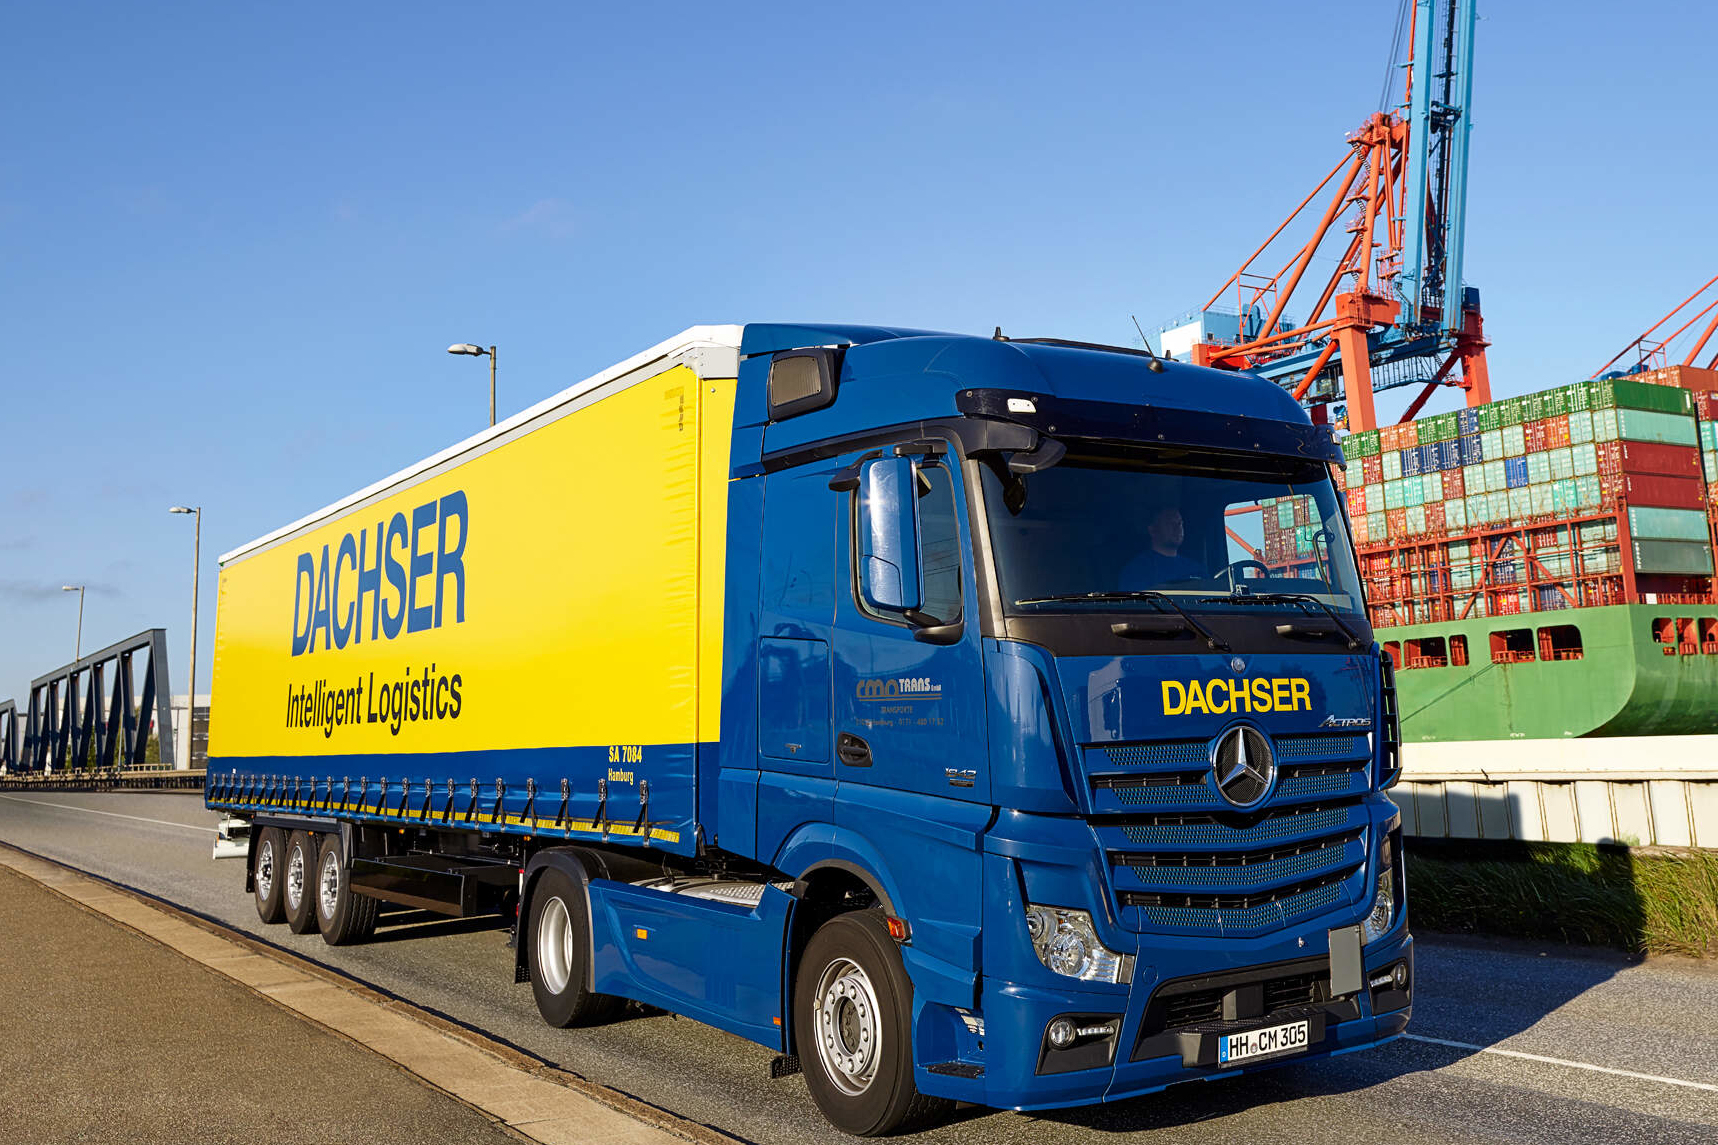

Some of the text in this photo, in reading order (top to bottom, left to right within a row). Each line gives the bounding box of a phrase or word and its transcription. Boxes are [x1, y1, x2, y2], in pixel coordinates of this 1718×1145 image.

[291, 489, 469, 656] DACHSER
[287, 663, 462, 738] Intelligent Logistics
[1161, 678, 1312, 715] DACHSER
[608, 745, 642, 762] SA 7084
[608, 768, 633, 785] Hamburg
[1229, 1024, 1306, 1057] HH CM 305
